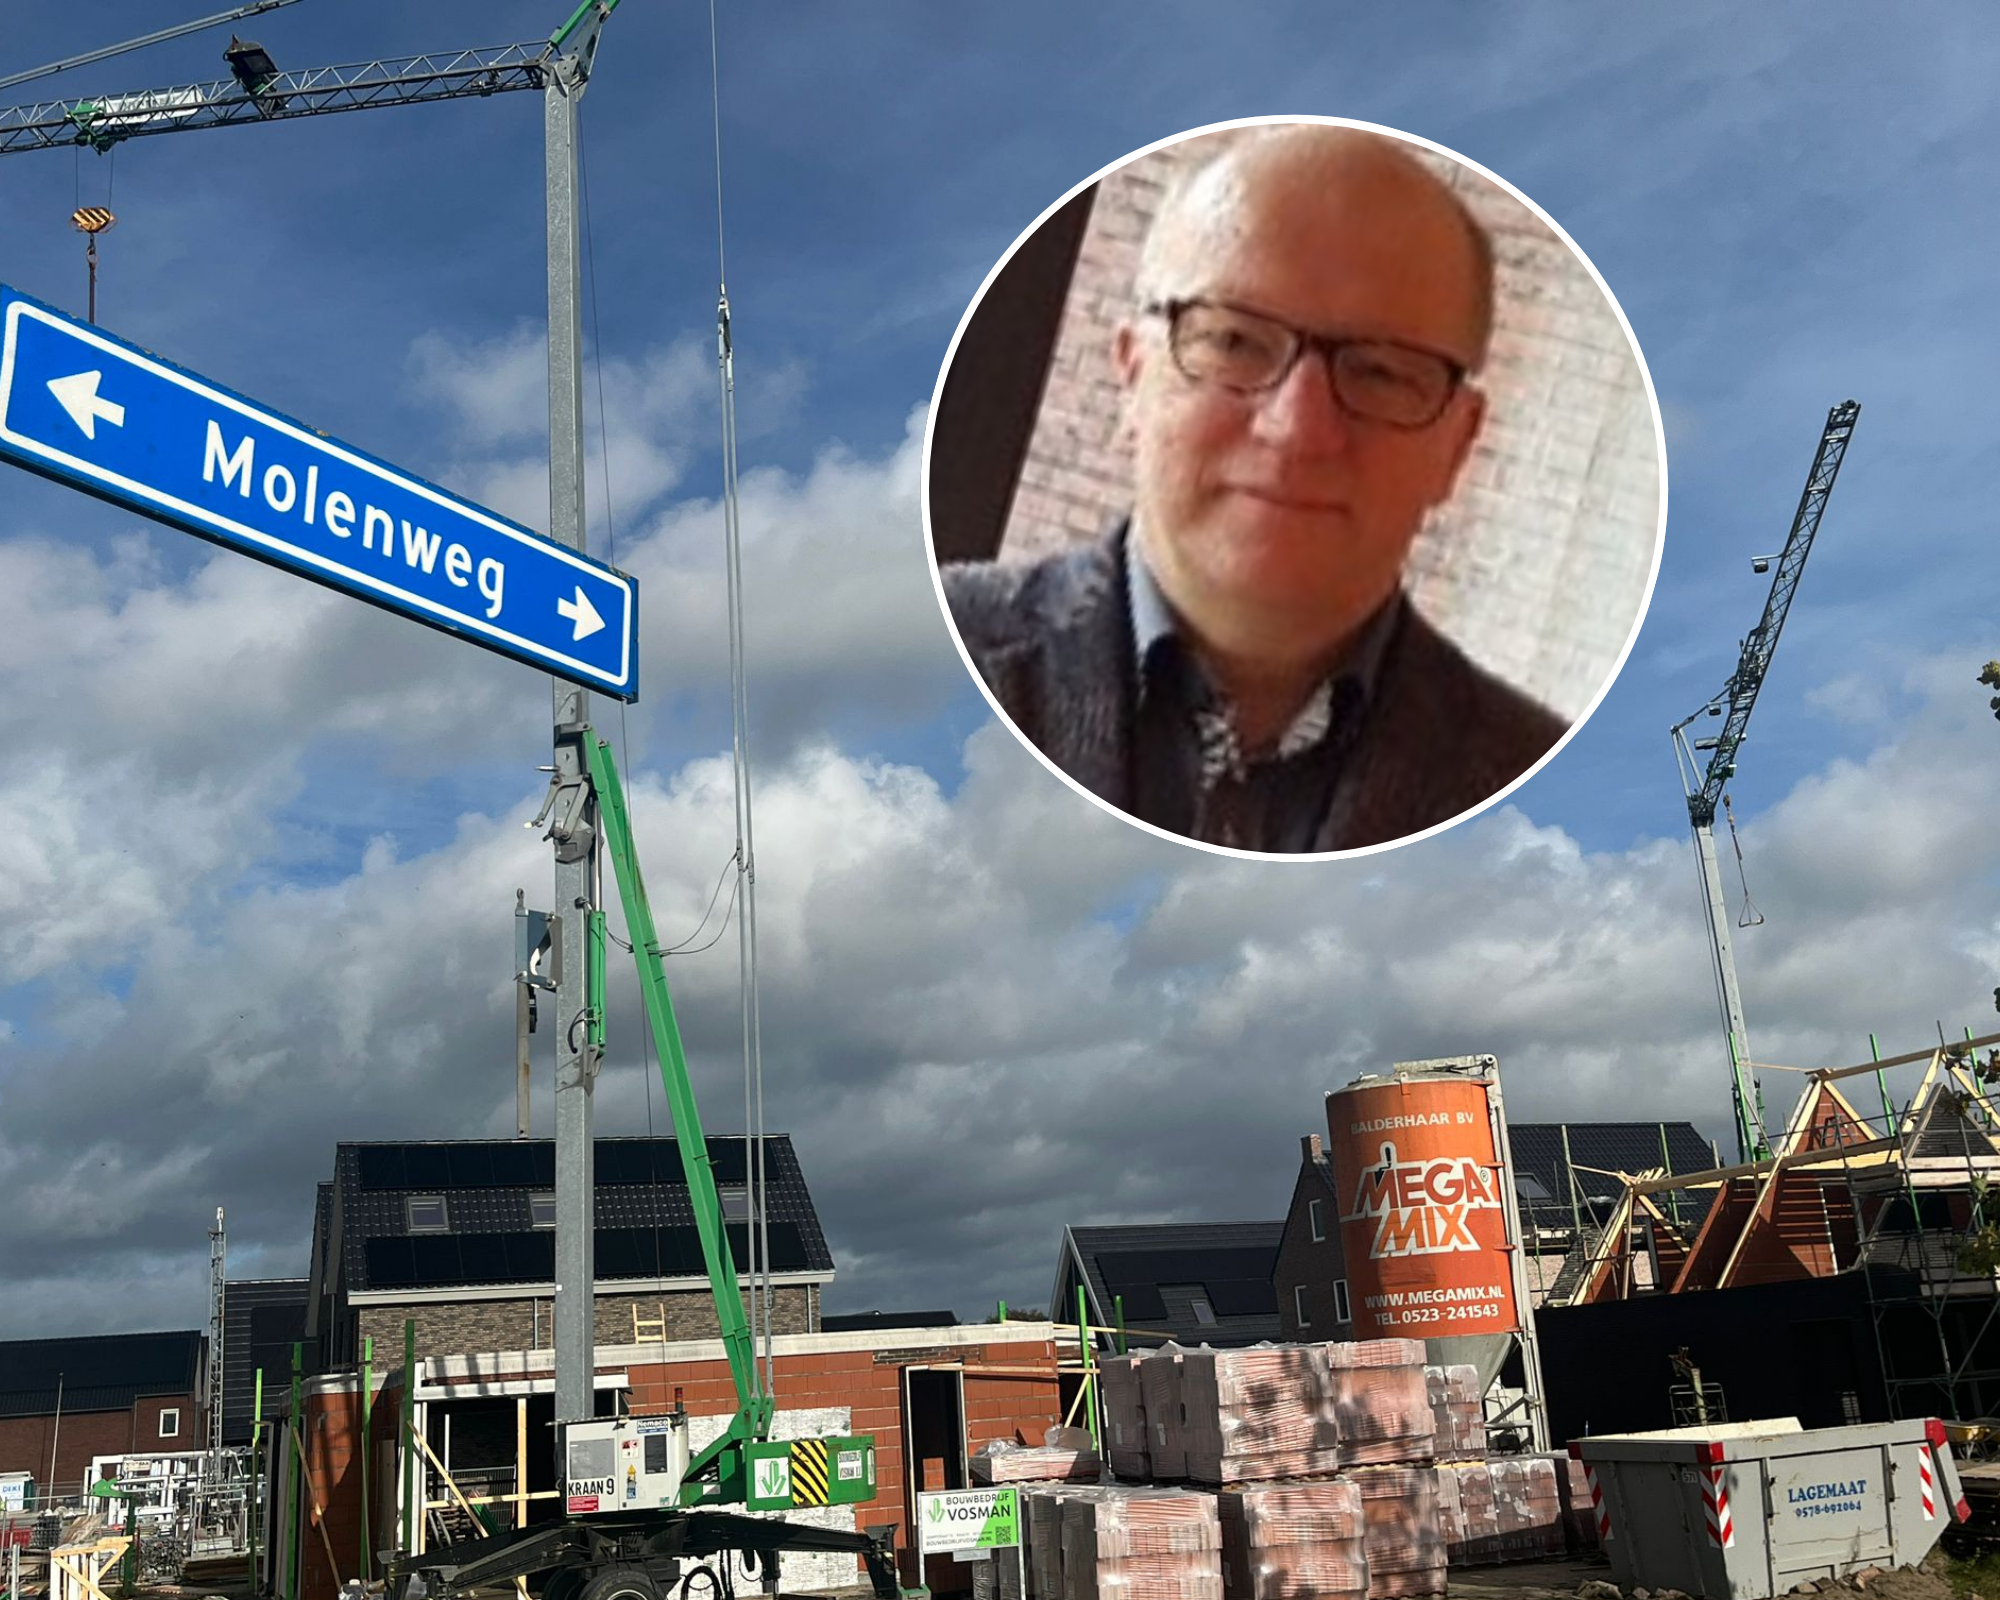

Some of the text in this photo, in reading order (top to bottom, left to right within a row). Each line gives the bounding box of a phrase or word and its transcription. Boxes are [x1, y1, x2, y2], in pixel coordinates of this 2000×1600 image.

[202, 419, 505, 619] Molenweg
[1350, 1111, 1475, 1135] BALDERHAAR BV
[1353, 1162, 1494, 1216] MEGA
[1373, 1204, 1473, 1252] MIX
[1364, 1286, 1505, 1309] WWW.MEGAMIX.NL
[1374, 1304, 1499, 1326] TEL. 0523-241543
[568, 1481, 604, 1496] KRAAN
[606, 1478, 615, 1495] 9
[1788, 1479, 1867, 1503] LAGEMAAT
[945, 1492, 1010, 1506] BOUWBEDRIJF
[1795, 1500, 1862, 1518] 0578-692064
[947, 1504, 1011, 1521] VOSMAN
